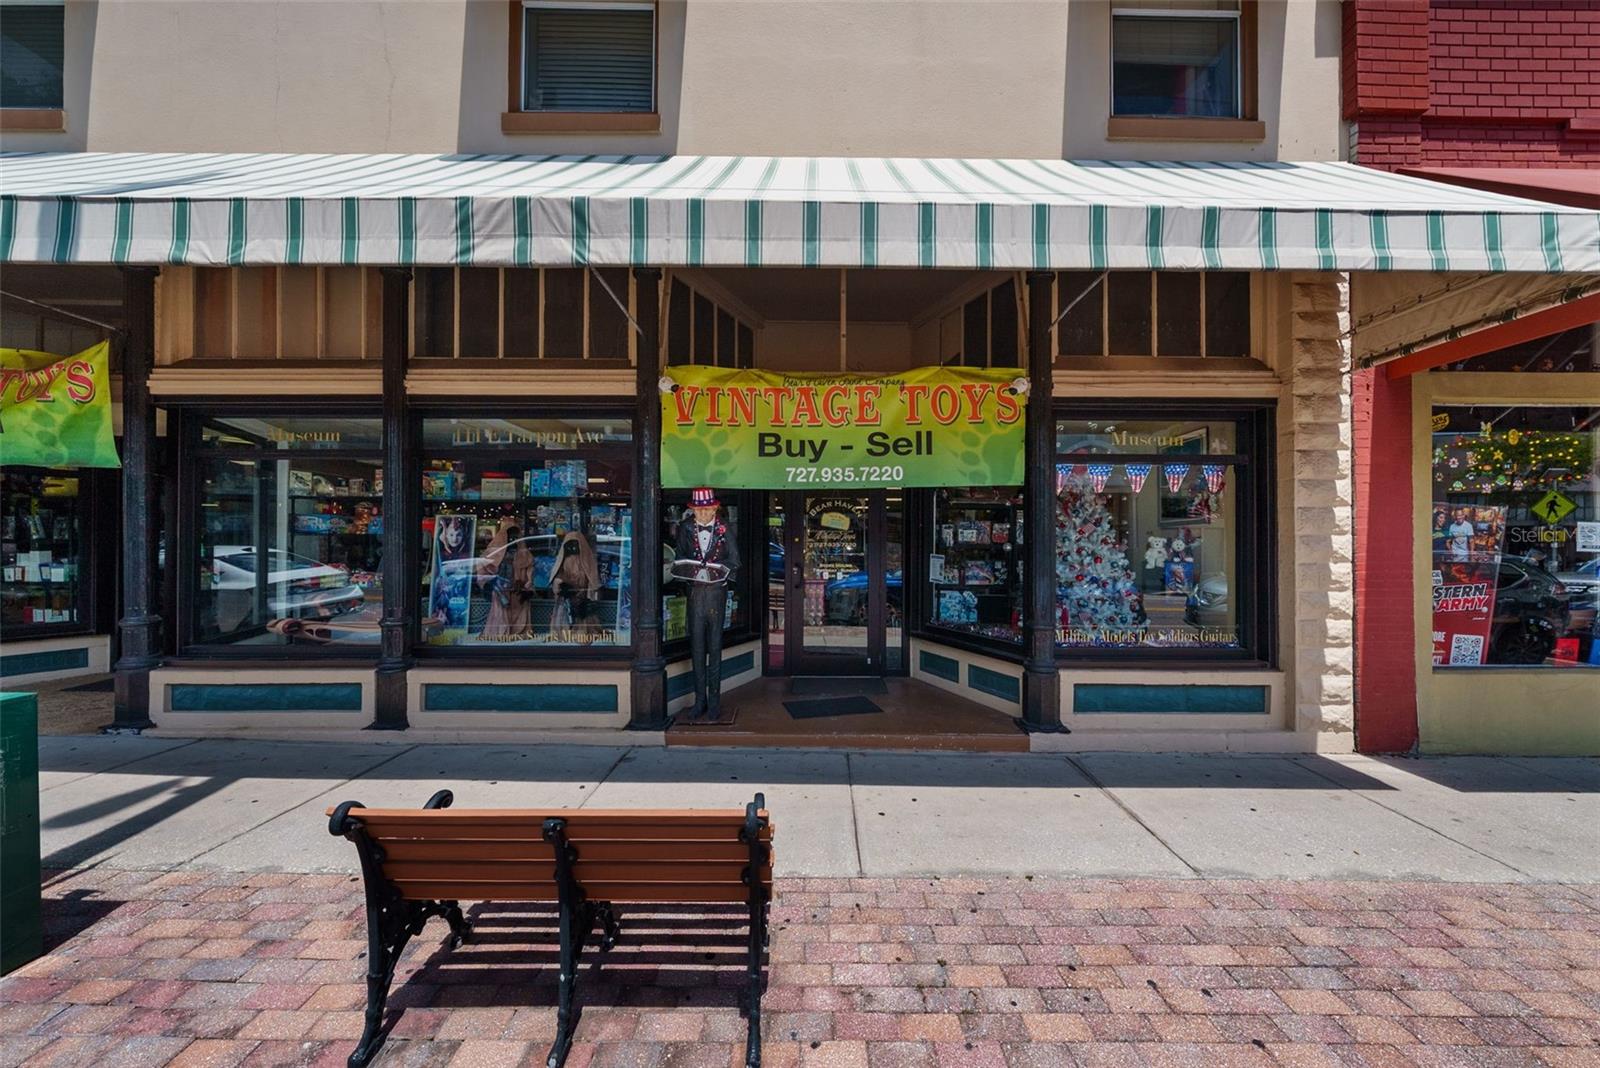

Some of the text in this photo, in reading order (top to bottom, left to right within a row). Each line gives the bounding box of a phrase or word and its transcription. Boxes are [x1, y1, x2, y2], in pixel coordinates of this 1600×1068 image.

[673, 383, 1022, 427] VINTAGE TOYS
[266, 425, 341, 442] Museum
[572, 426, 604, 444] Ave
[1111, 430, 1185, 447] Museum
[758, 432, 829, 464] Buy
[866, 430, 933, 458] Sell
[785, 465, 904, 484] 727.935.7220
[809, 501, 833, 517] BEAR
[1433, 584, 1487, 600] STERN
[1437, 596, 1489, 612] ARMY
[526, 629, 559, 644] Sports
[561, 628, 625, 643] Memorabil
[1055, 628, 1097, 644] Military
[1101, 629, 1136, 643] Models
[1138, 629, 1155, 645] Toy
[1158, 629, 1199, 643] Soldiers
